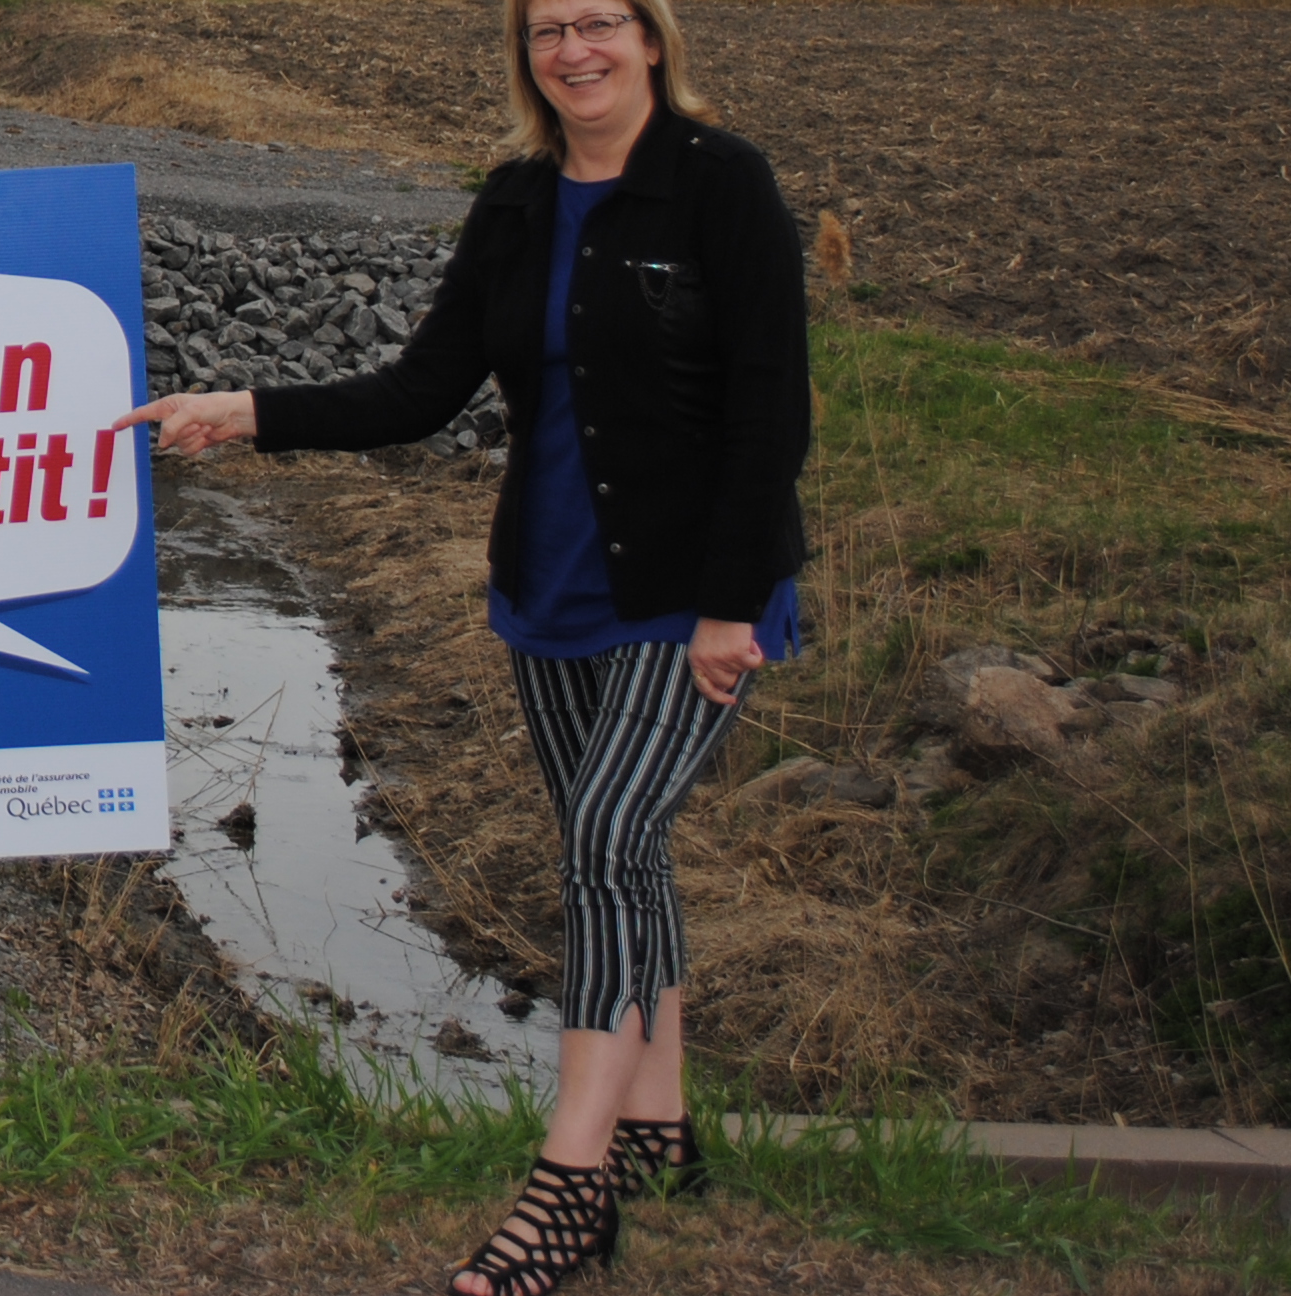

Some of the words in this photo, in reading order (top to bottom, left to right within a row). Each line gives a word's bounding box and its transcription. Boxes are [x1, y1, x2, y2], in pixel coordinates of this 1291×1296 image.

[15, 774, 29, 784] de
[31, 771, 91, 783] l'assurance
[6, 795, 93, 821] Québec
